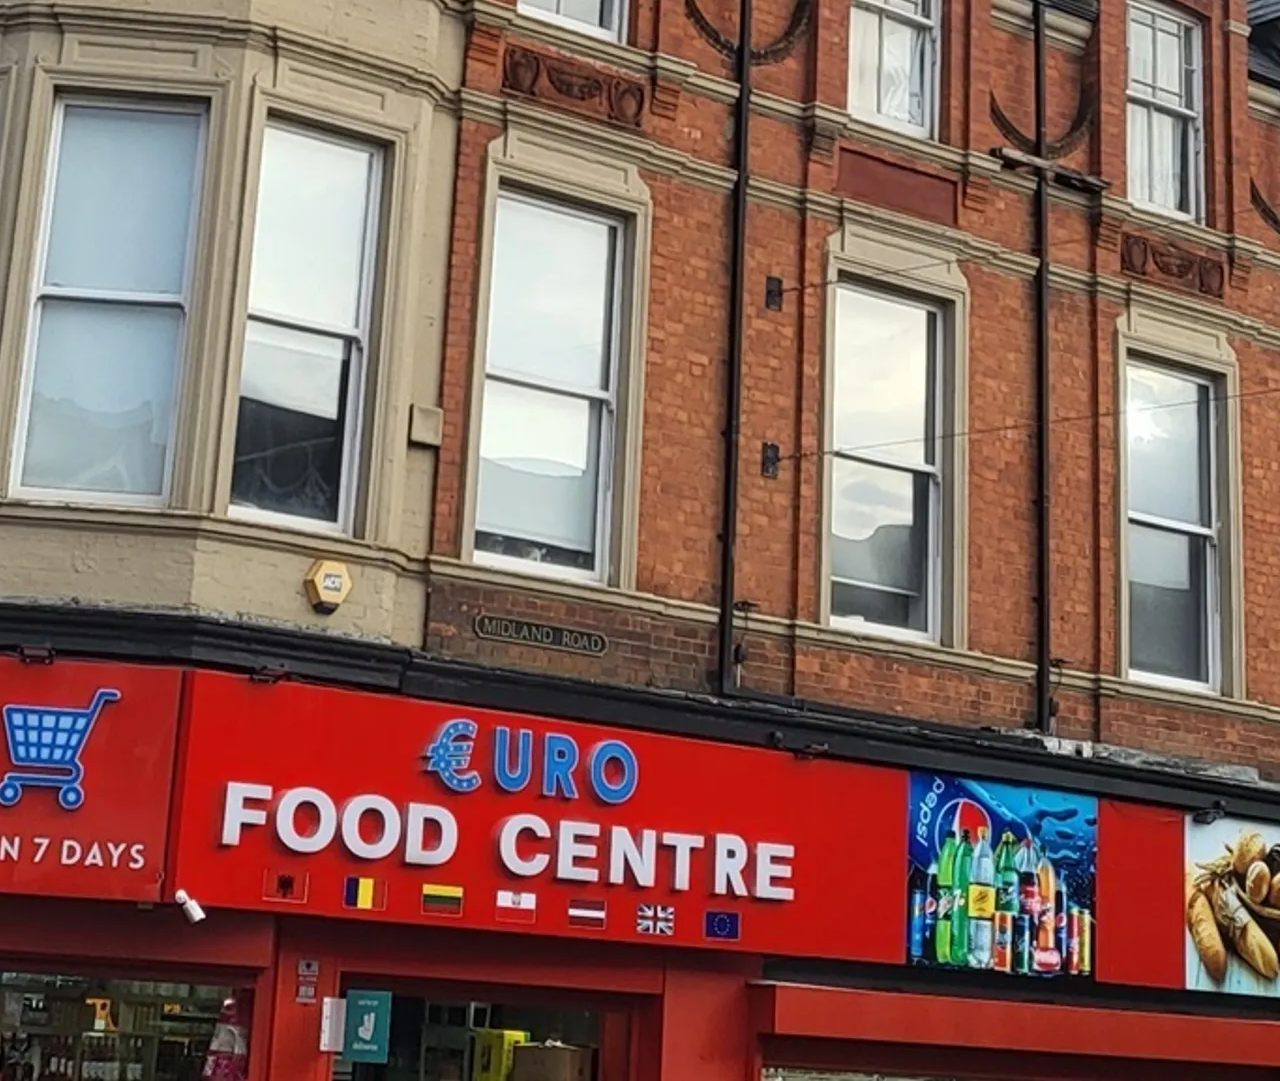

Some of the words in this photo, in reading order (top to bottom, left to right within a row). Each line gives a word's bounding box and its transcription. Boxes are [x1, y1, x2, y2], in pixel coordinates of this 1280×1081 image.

[483, 618, 553, 644] MIDLAND
[562, 630, 602, 651] ROAD
[33, 837, 52, 863] 7
[60, 838, 146, 870] DAYS
[221, 781, 459, 865] FOOD
[497, 813, 796, 901] CENTRE
